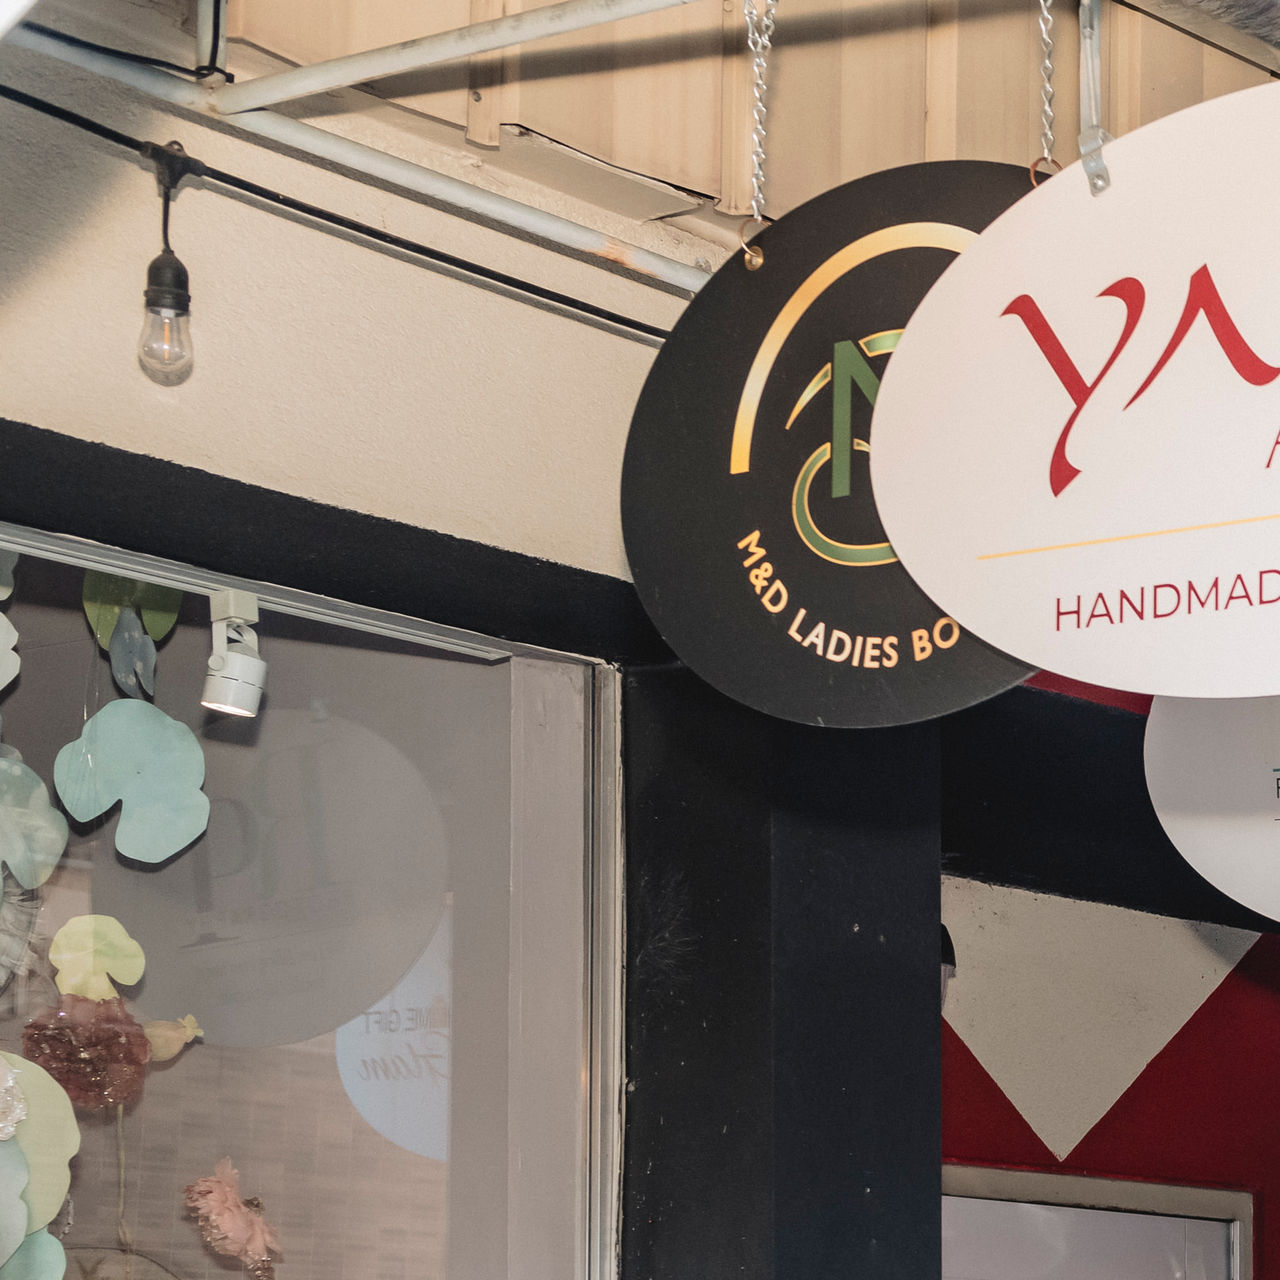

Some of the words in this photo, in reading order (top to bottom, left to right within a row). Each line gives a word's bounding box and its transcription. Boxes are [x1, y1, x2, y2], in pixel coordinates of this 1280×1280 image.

[737, 529, 789, 615] M&D
[787, 607, 899, 670] LADIES
[911, 615, 962, 662] BO
